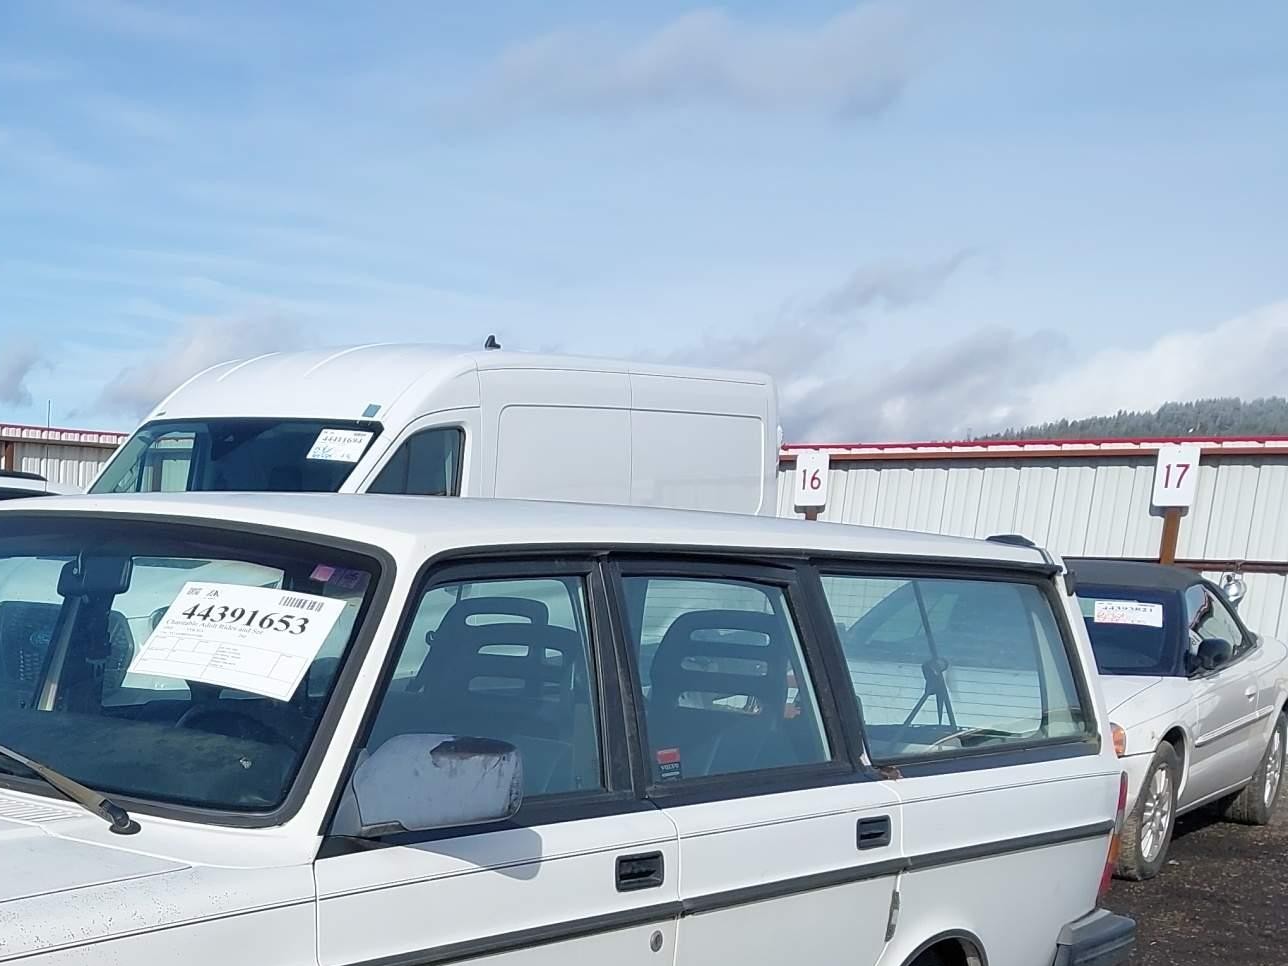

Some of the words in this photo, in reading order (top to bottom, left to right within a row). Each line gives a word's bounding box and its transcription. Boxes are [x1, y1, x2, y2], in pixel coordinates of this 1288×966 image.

[802, 468, 821, 490] 16
[1164, 463, 1191, 488] 17
[182, 603, 309, 635] 44391653
